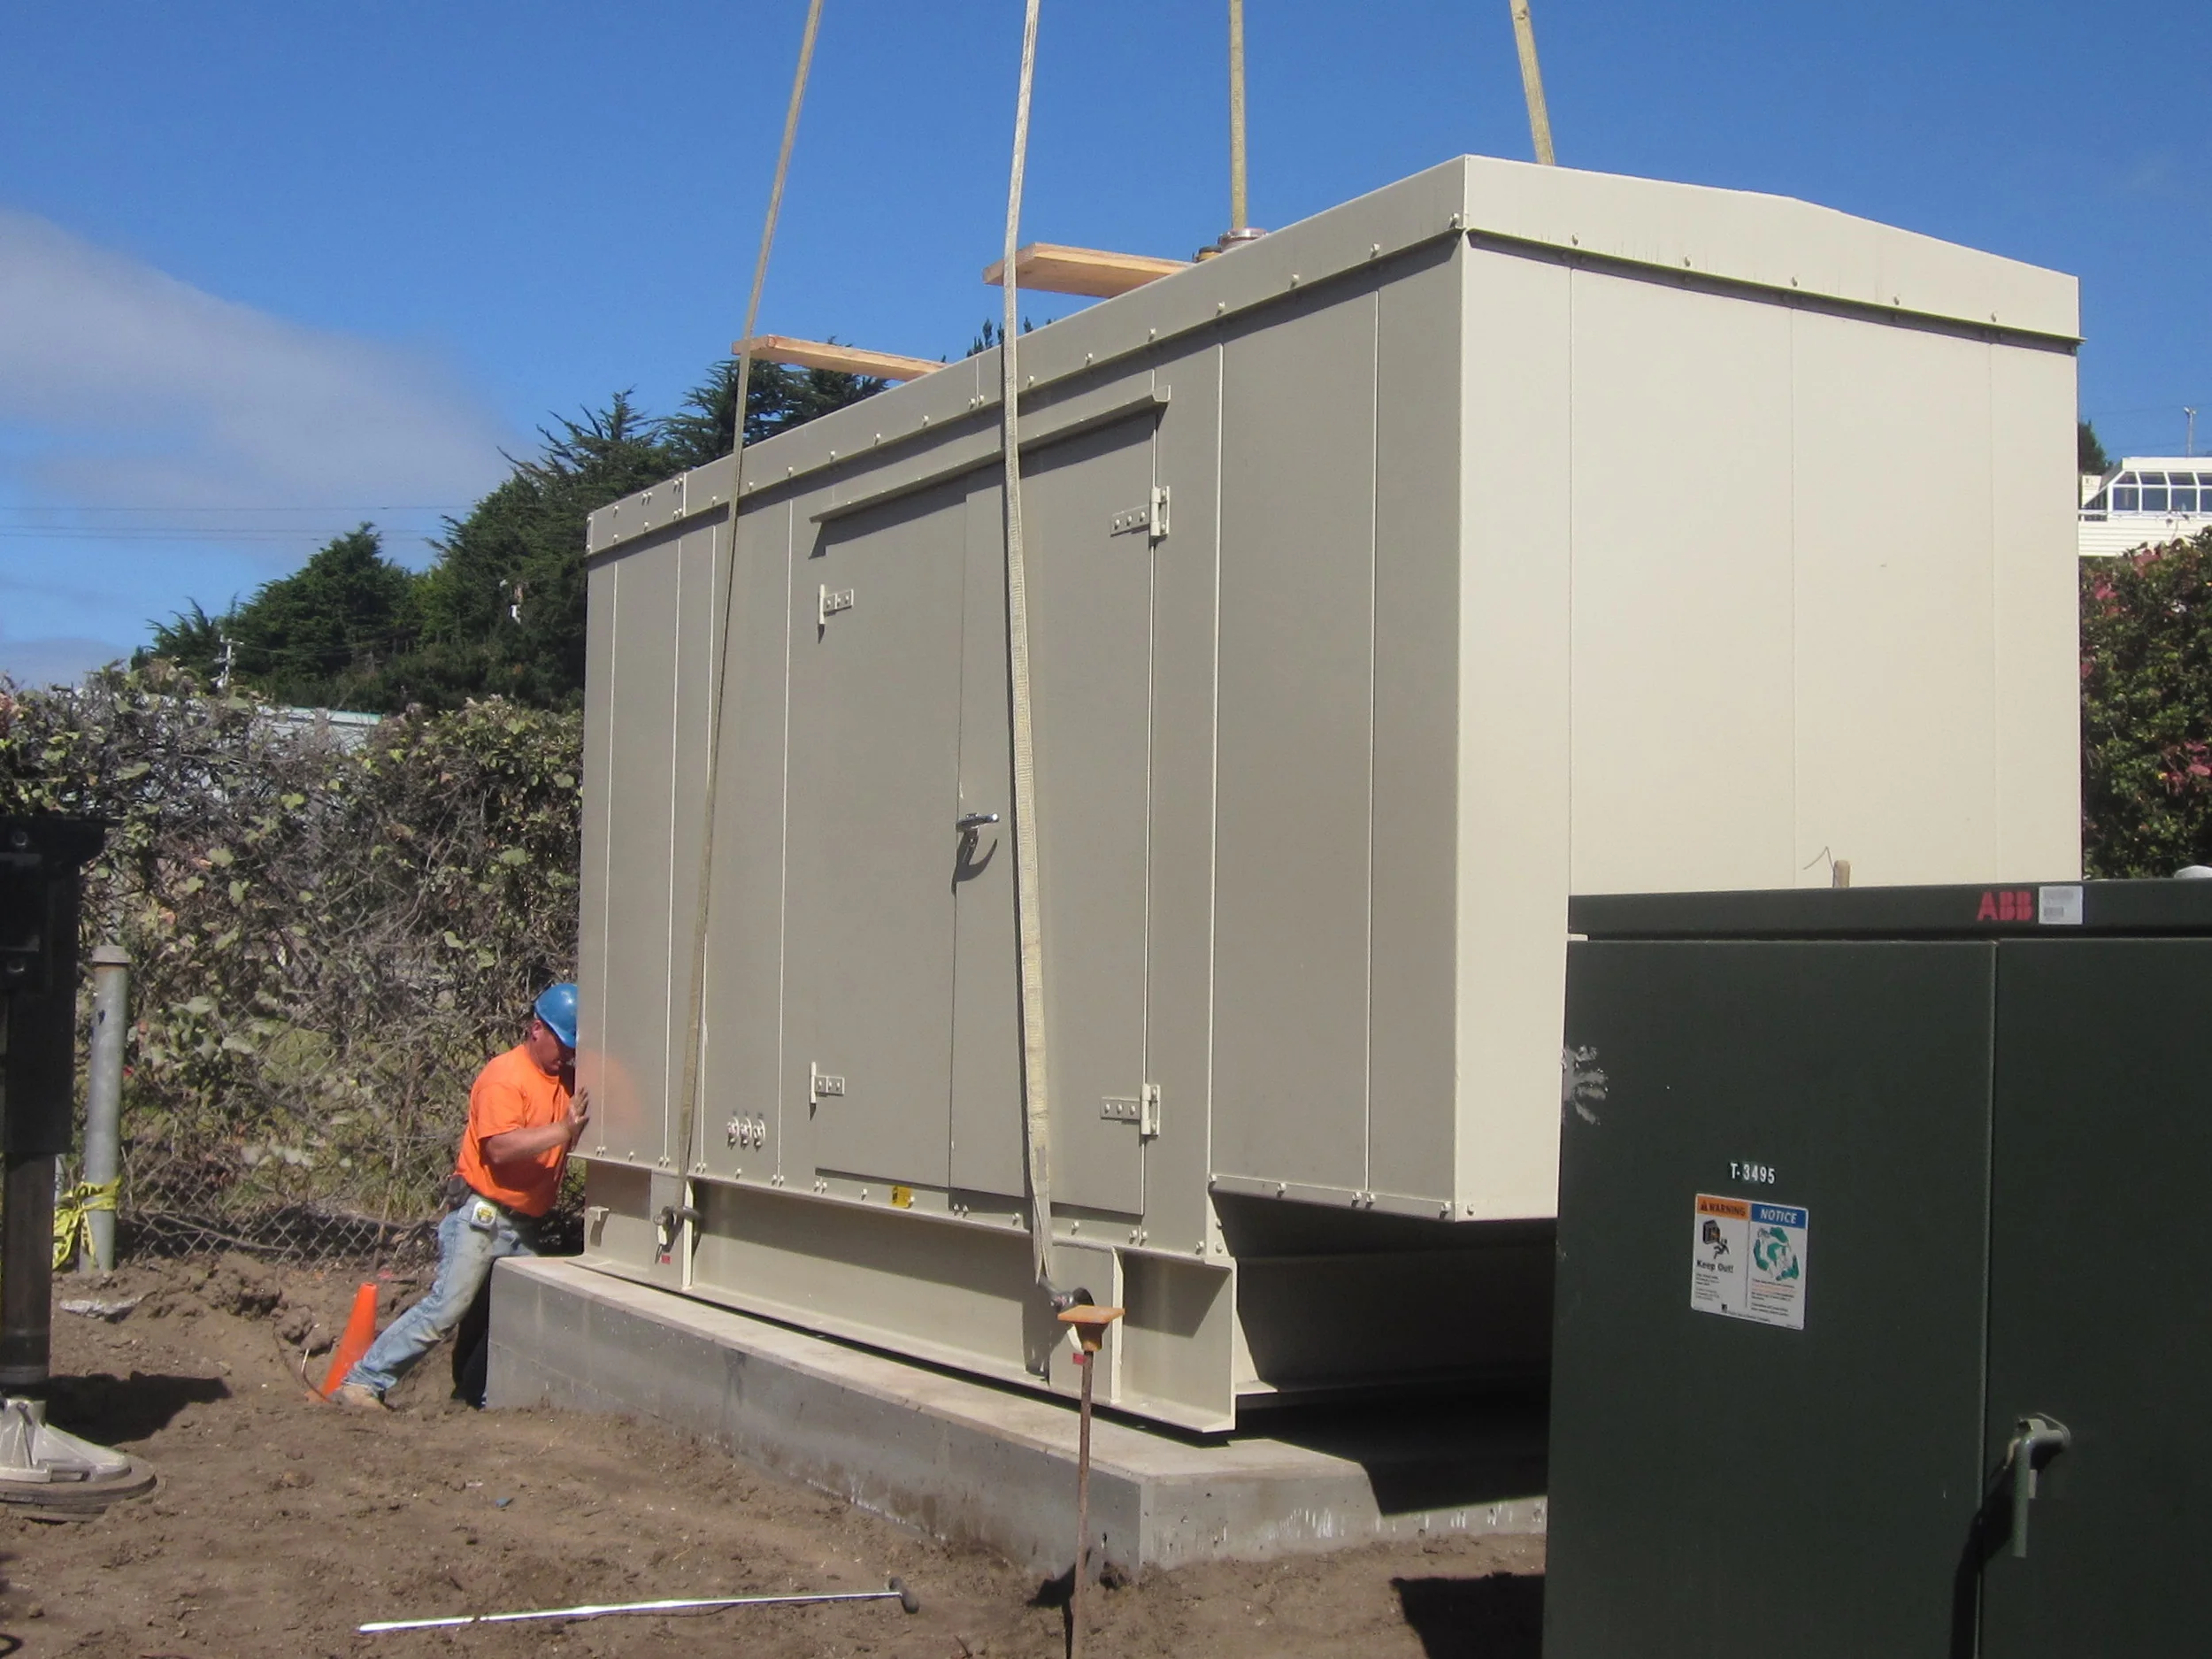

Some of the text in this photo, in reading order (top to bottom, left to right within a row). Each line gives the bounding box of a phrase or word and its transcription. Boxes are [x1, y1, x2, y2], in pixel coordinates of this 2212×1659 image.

[1977, 891, 2032, 921] ABB
[1709, 1202, 1746, 1217] WARNING
[1760, 1208, 1797, 1224] NOTICE
[1696, 1259, 1716, 1272] Keep
